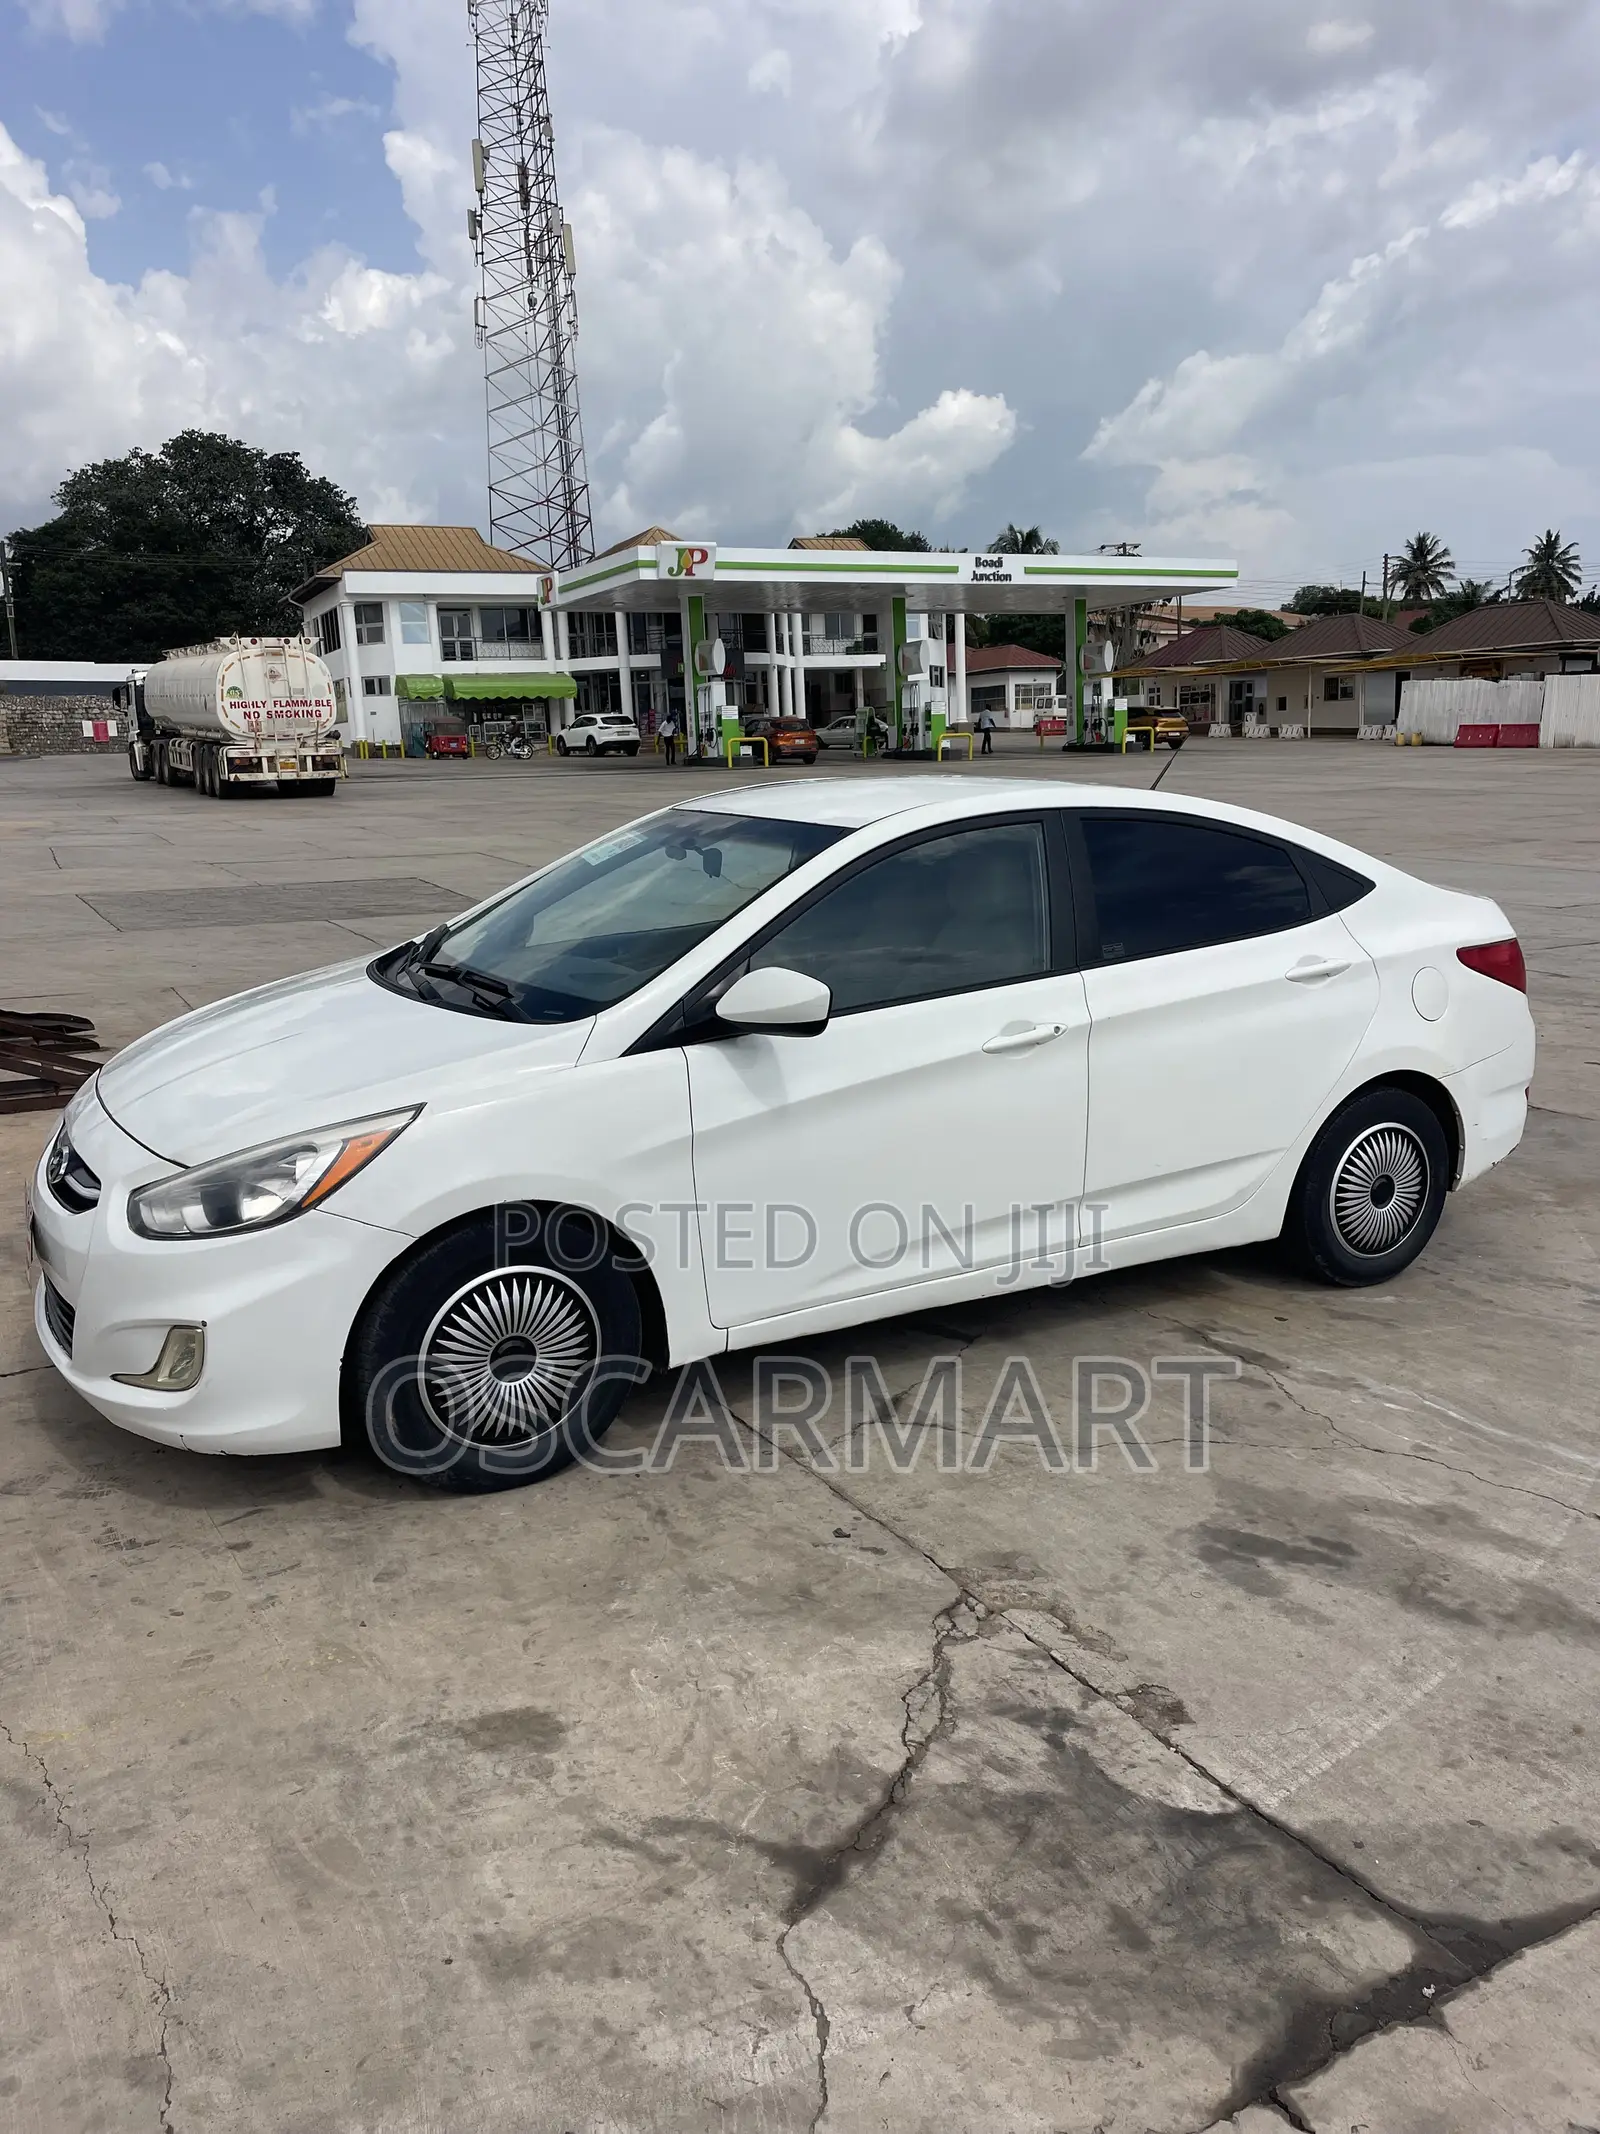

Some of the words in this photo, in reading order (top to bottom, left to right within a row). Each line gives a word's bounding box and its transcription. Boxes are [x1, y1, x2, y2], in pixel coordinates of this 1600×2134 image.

[667, 548, 709, 577] JP
[975, 556, 1003, 568] Boadi
[971, 570, 1012, 582] Junction
[229, 700, 267, 709] HIGHLY
[273, 699, 332, 708] FLAMMABLE
[243, 711, 261, 720] NO
[266, 709, 322, 719] SMOKING
